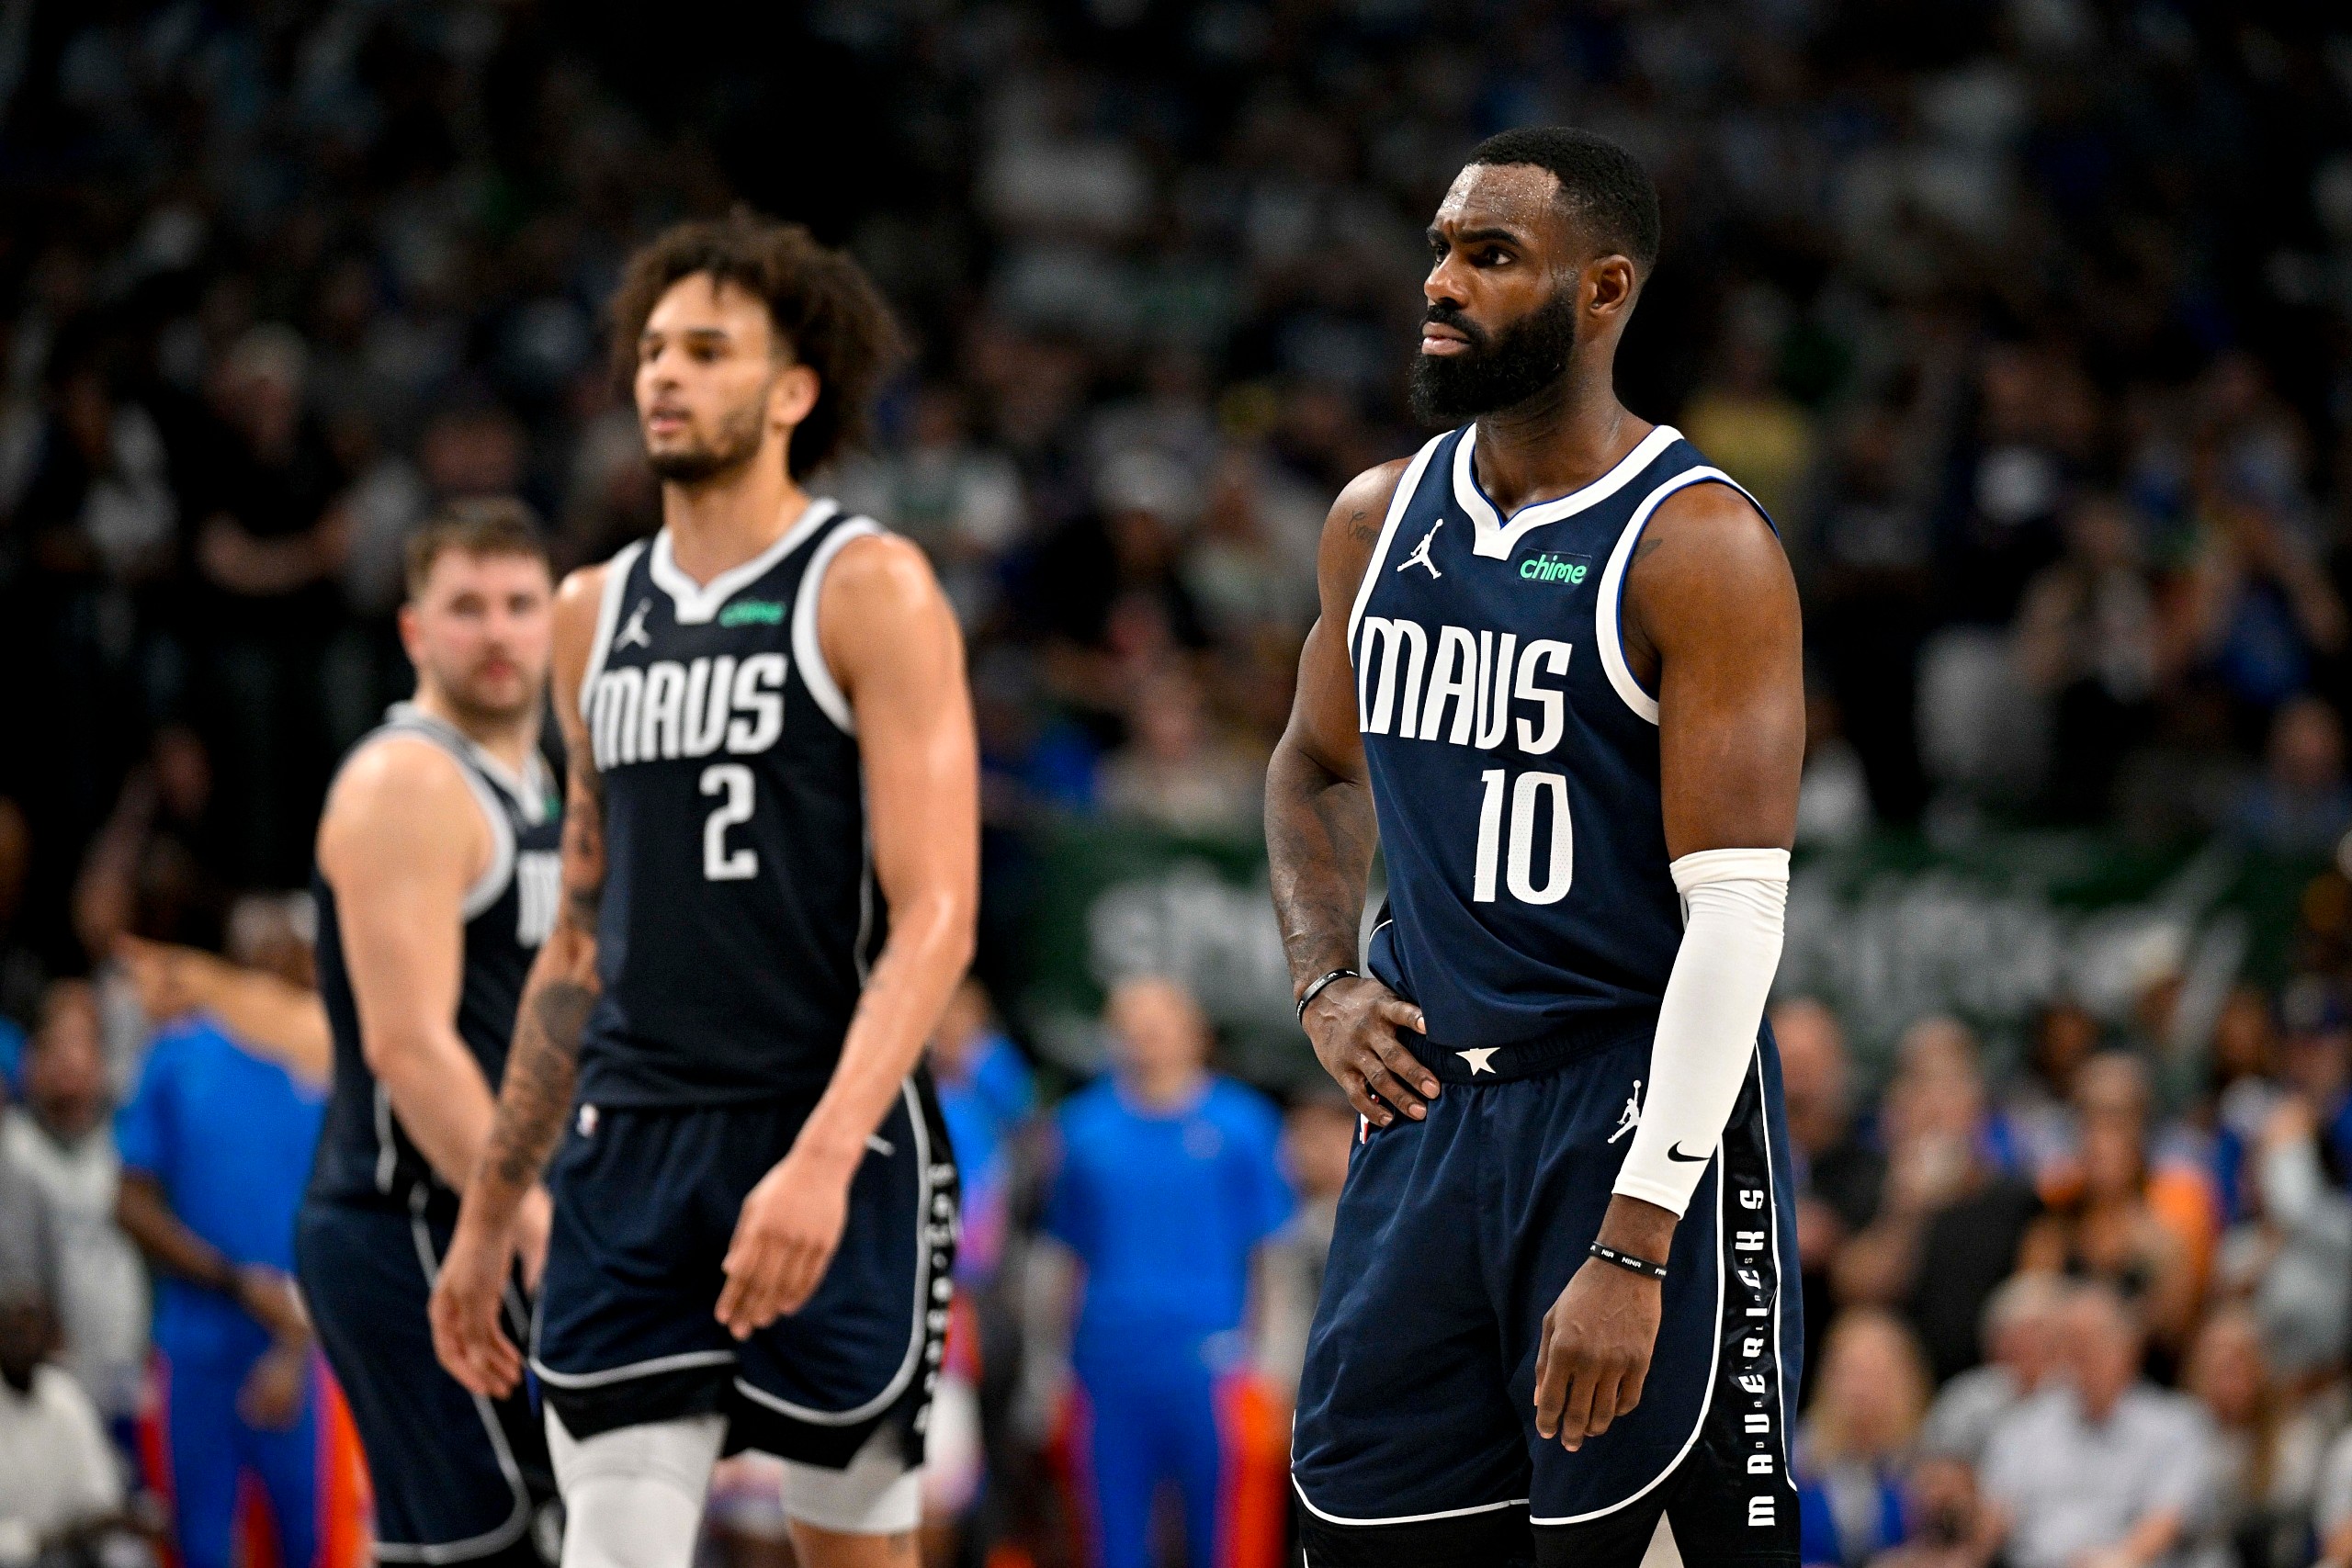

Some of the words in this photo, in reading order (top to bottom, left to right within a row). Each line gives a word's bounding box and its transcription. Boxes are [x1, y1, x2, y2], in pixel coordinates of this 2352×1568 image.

[1520, 554, 1588, 584] chime
[591, 653, 789, 773] MAVS
[1359, 615, 1573, 755] MAVS
[699, 763, 759, 881] 2
[1473, 768, 1574, 906] 10
[1600, 1249, 1614, 1258] NIA
[1622, 1257, 1642, 1268] NINA
[1735, 1189, 1776, 1527] MAVERICKS
